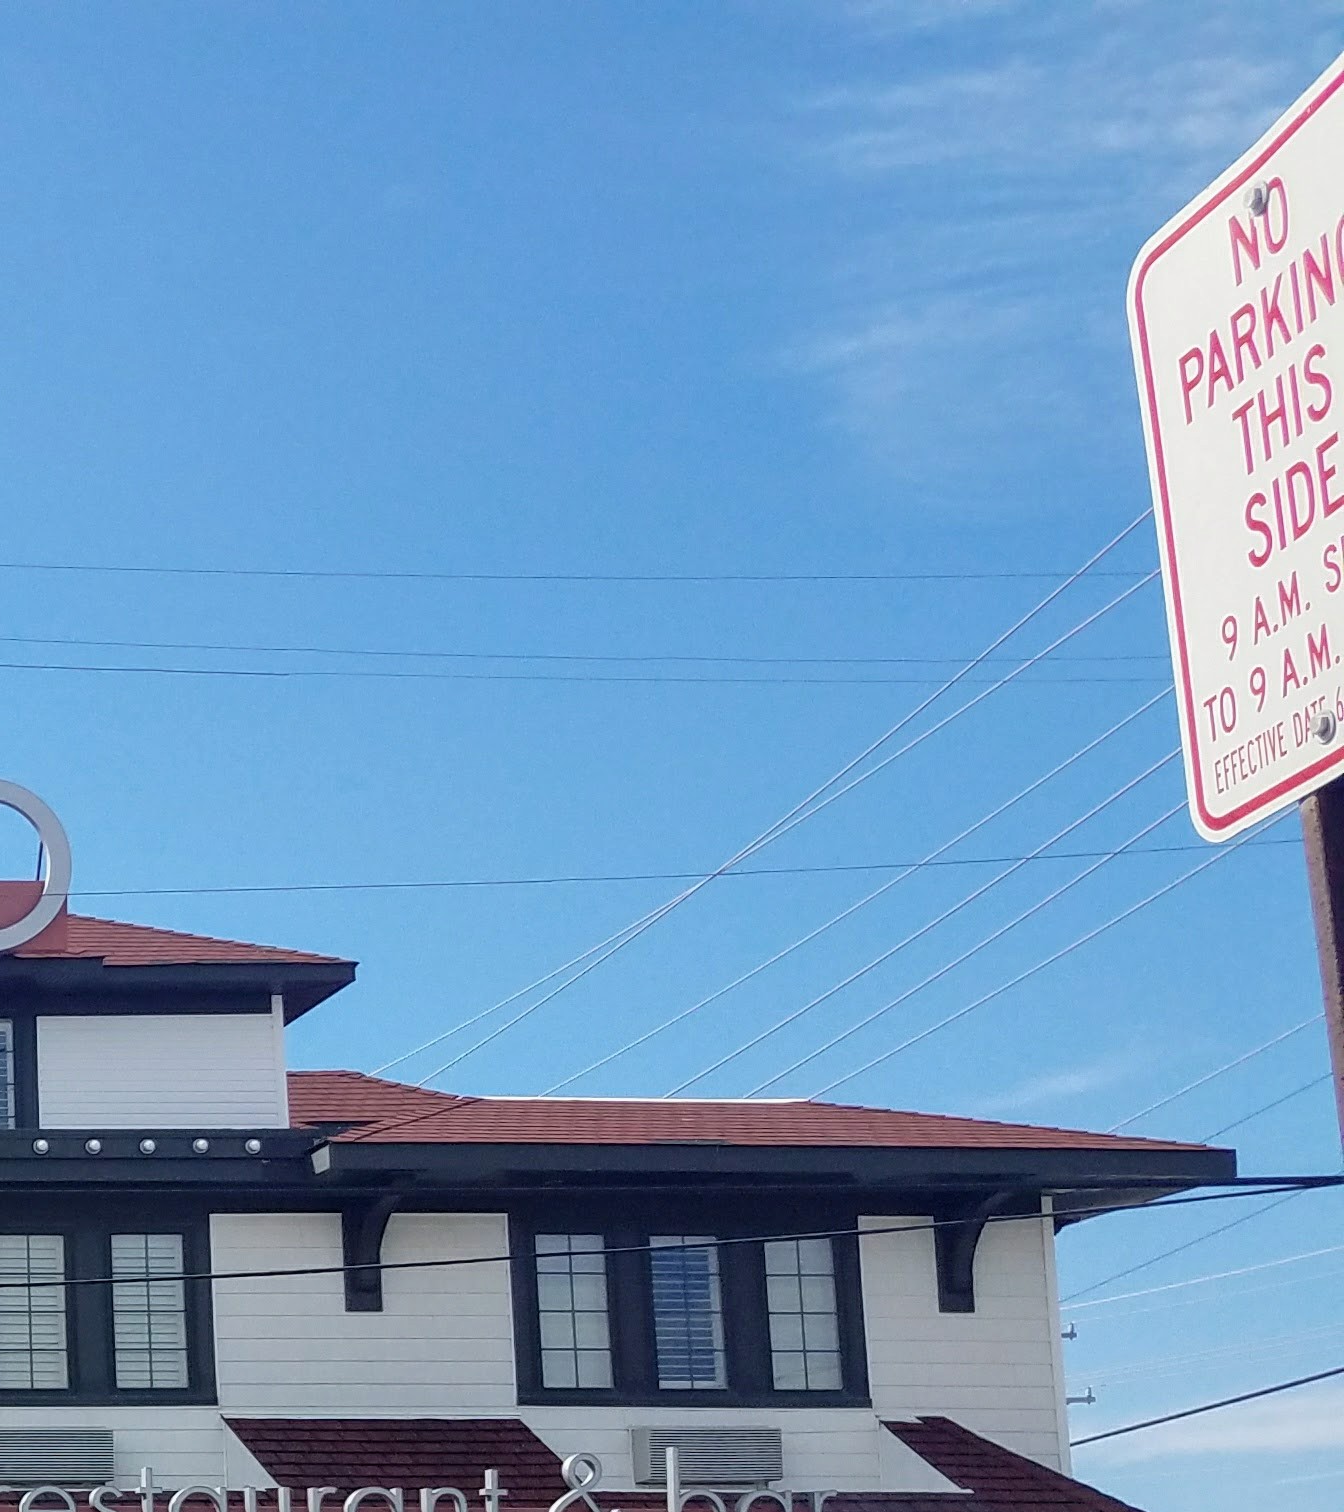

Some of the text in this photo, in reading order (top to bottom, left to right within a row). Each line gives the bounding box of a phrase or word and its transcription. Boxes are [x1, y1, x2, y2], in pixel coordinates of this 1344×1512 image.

[1229, 176, 1288, 286] NO
[1179, 213, 1344, 425] PARKIN
[1232, 343, 1332, 475] THIS
[1245, 431, 1344, 568] SIDE
[1221, 535, 1344, 661] 9 A.M. S
[1203, 623, 1341, 742] TO 9 A.M.
[1214, 721, 1288, 795] EFFECTIVE
